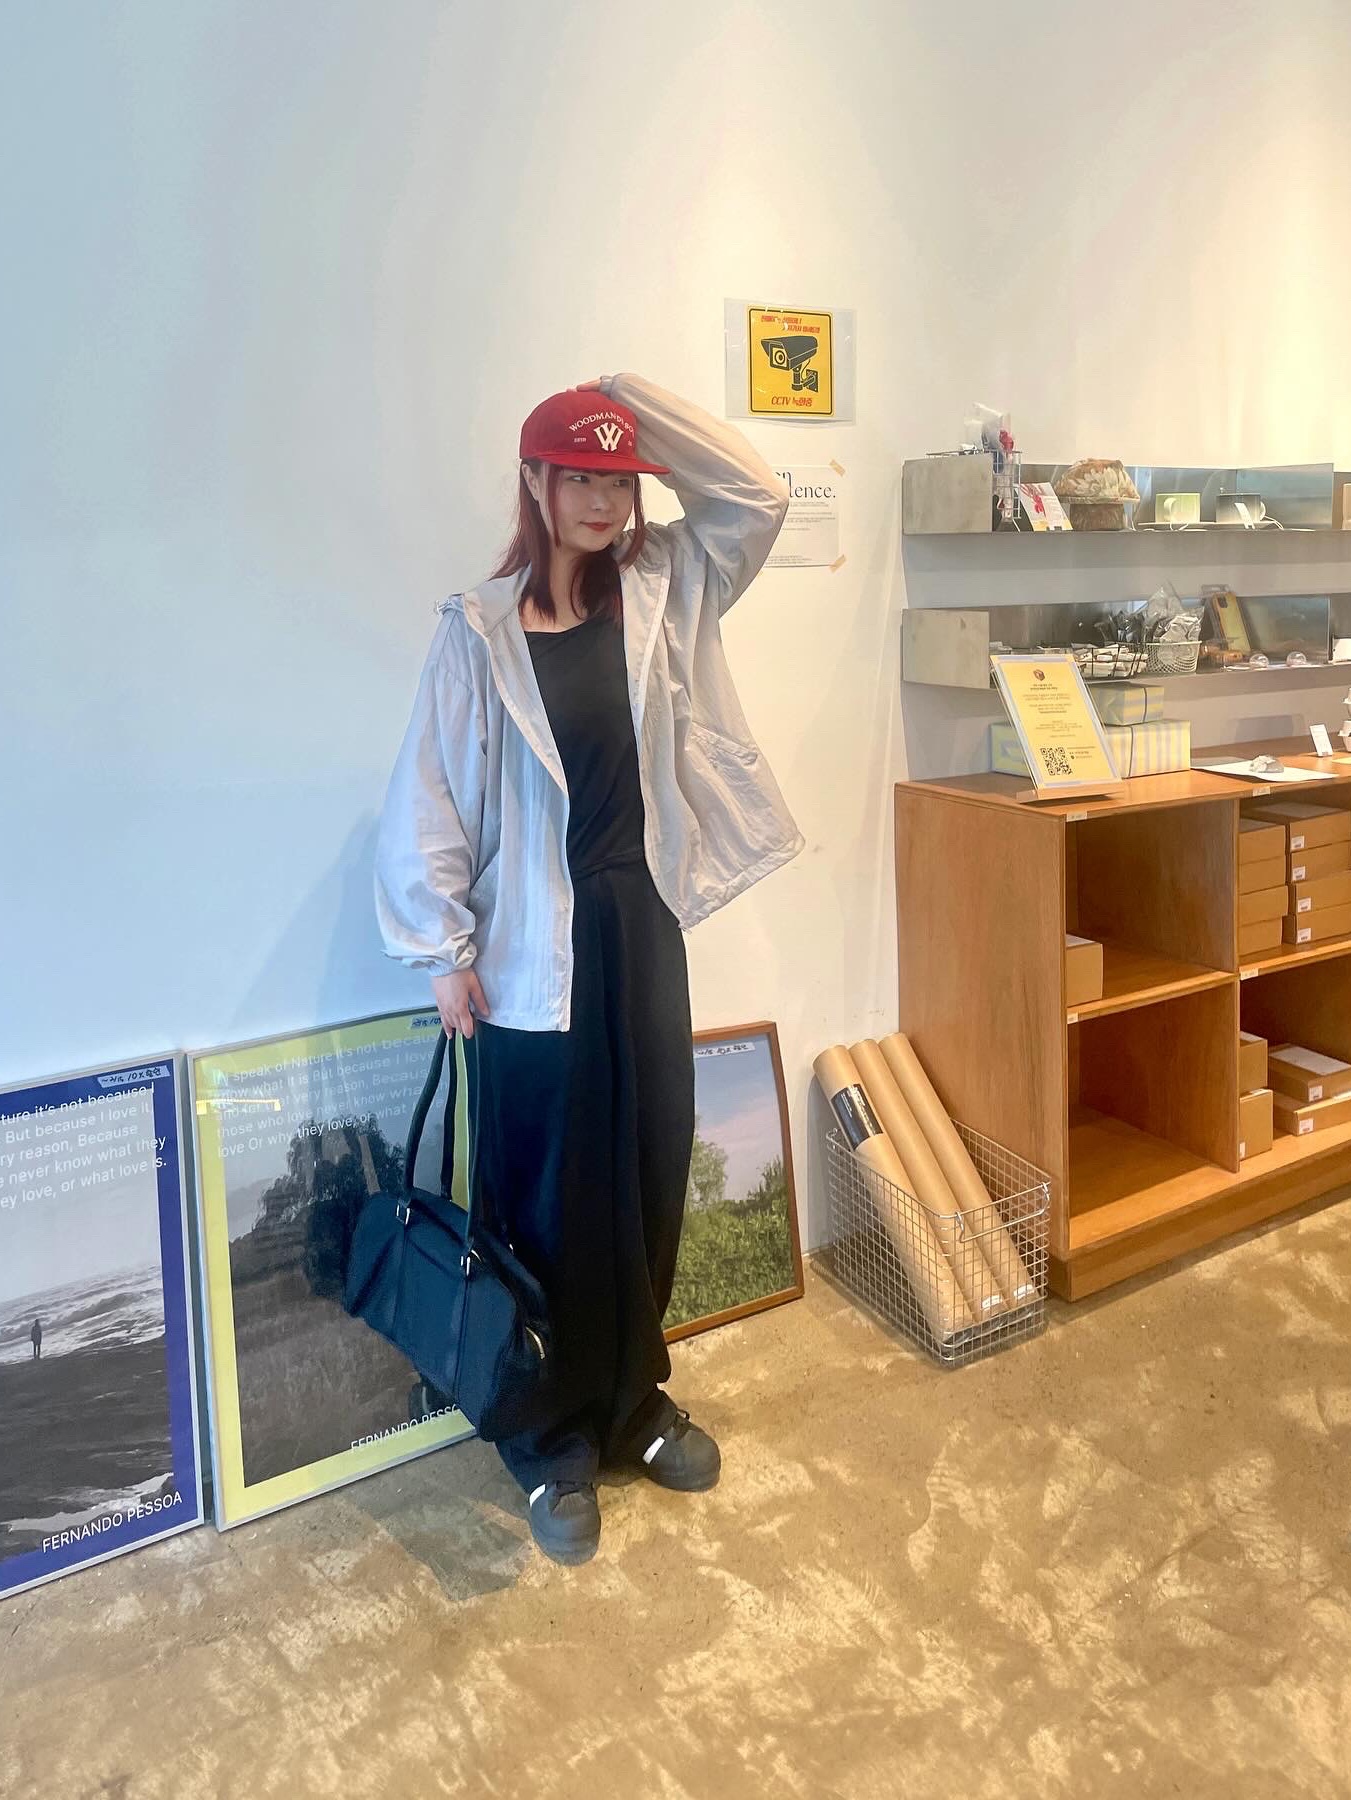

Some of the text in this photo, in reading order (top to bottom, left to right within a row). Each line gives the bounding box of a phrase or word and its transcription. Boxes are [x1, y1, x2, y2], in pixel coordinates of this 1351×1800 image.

[772, 396, 791, 406] CCTV
[593, 422, 624, 451] W
[774, 471, 837, 499] lence.
[234, 1065, 270, 1083] speak
[275, 1059, 288, 1073] of
[291, 1052, 333, 1070] Nature
[356, 1042, 377, 1056] not
[299, 1073, 308, 1085] is
[336, 1057, 391, 1076] because
[0, 1110, 31, 1126] ture
[35, 1103, 56, 1118] it's
[60, 1097, 83, 1111] not
[88, 1086, 147, 1107] because
[293, 1089, 321, 1104] very
[373, 1069, 428, 1086] Becaus
[5, 1127, 31, 1144] But
[35, 1115, 96, 1137] because
[109, 1106, 137, 1121] love
[257, 1113, 285, 1129] who
[287, 1109, 313, 1123] love
[353, 1092, 385, 1108] know
[389, 1085, 421, 1099] wha
[0, 1124, 138, 1168] ry reason, Because
[217, 1141, 245, 1159] love
[248, 1137, 263, 1151] Or
[267, 1128, 293, 1148] why
[297, 1120, 325, 1138] they
[360, 1112, 371, 1124] or
[375, 1103, 407, 1120] what
[9, 1165, 49, 1185] never
[54, 1154, 93, 1174] know
[98, 1143, 132, 1161] what
[136, 1136, 166, 1153] they
[0, 1156, 167, 1210] ey love, or what love is.
[350, 1418, 418, 1450] FERNANDO
[42, 1490, 183, 1553] FERNANDO PESSOA
